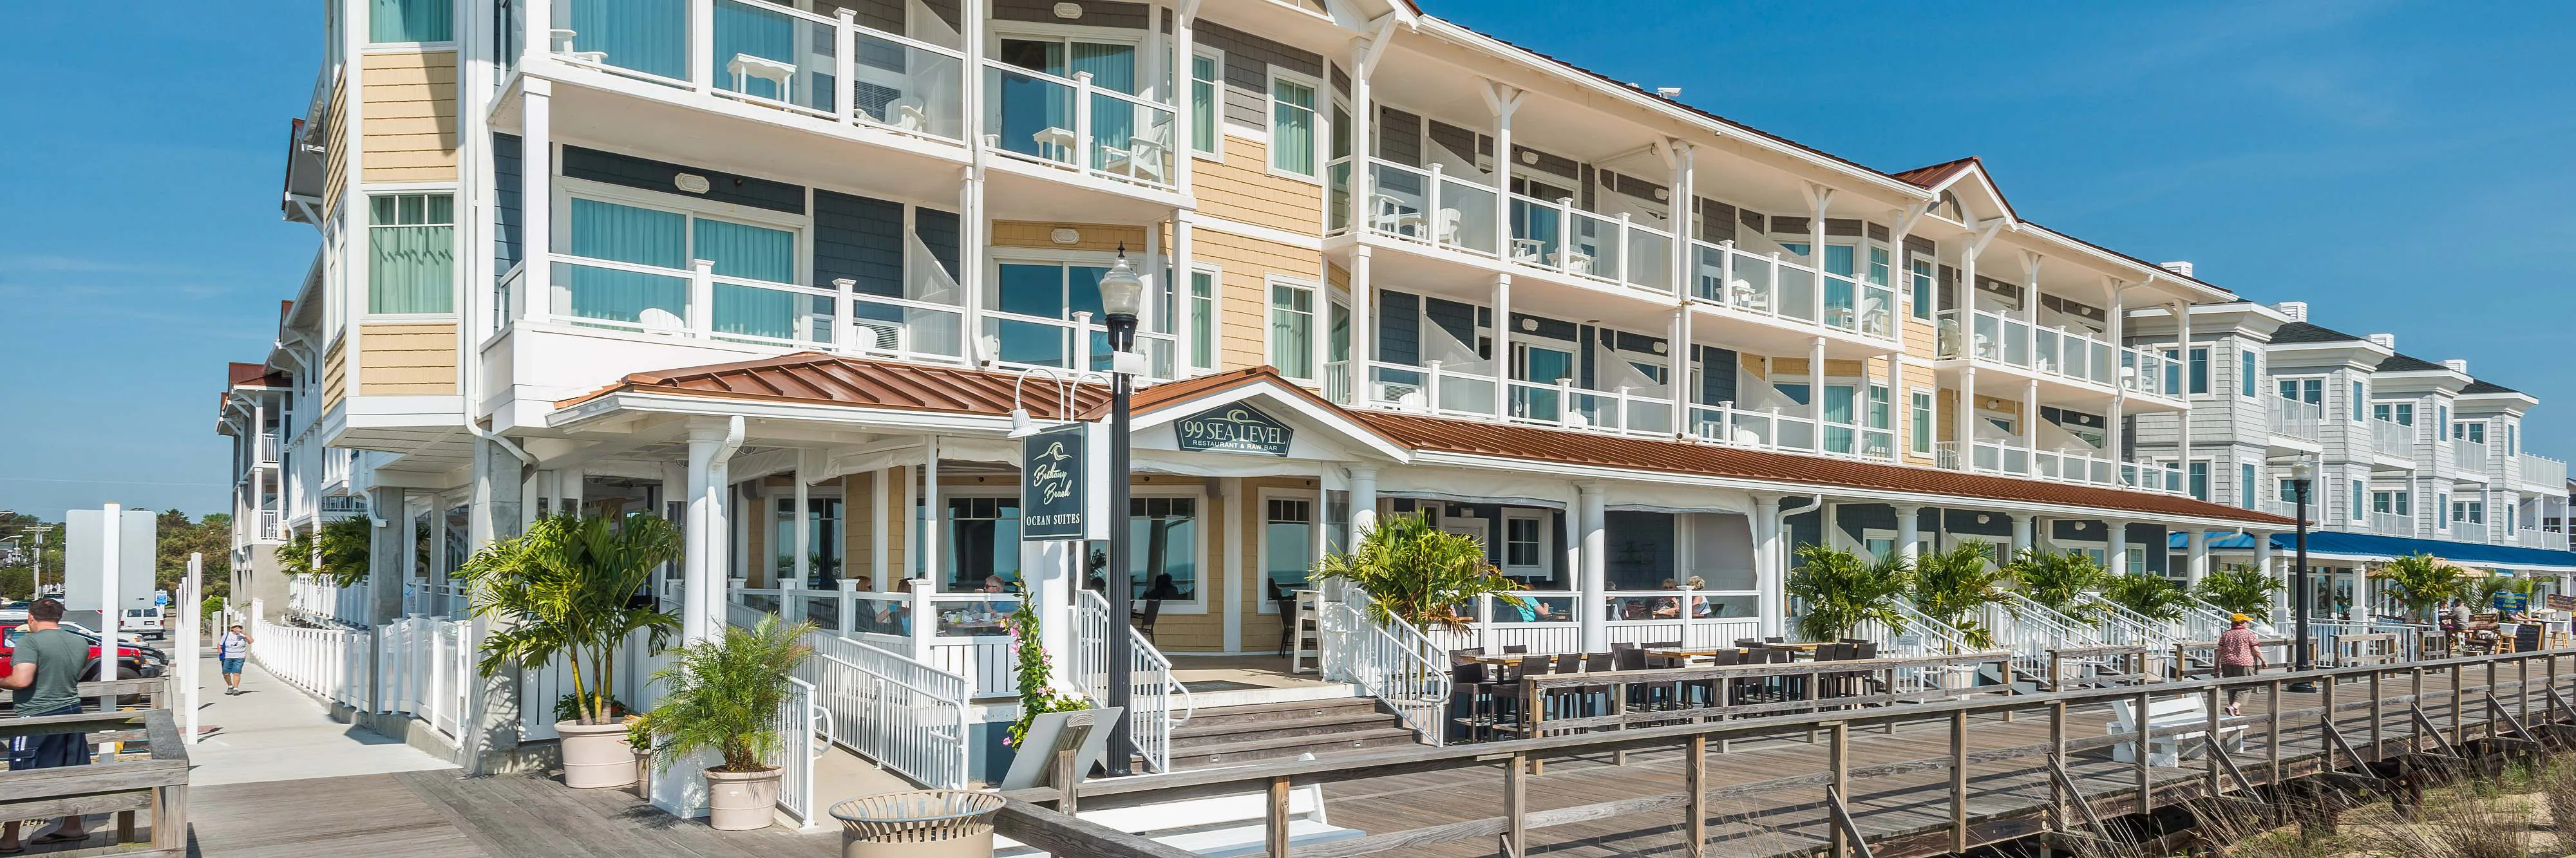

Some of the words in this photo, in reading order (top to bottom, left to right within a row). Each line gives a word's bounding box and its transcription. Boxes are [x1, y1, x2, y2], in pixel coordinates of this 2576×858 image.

[1184, 421, 1204, 438] 99
[1206, 422, 1235, 440] SEA
[1238, 425, 1285, 445] LEVEL
[1192, 440, 1238, 449] RESTAURANT
[1034, 462, 1068, 487] Bethany
[1043, 480, 1072, 505] Beach
[1027, 516, 1051, 526] OCEAN
[1054, 514, 1080, 525] SUITES
